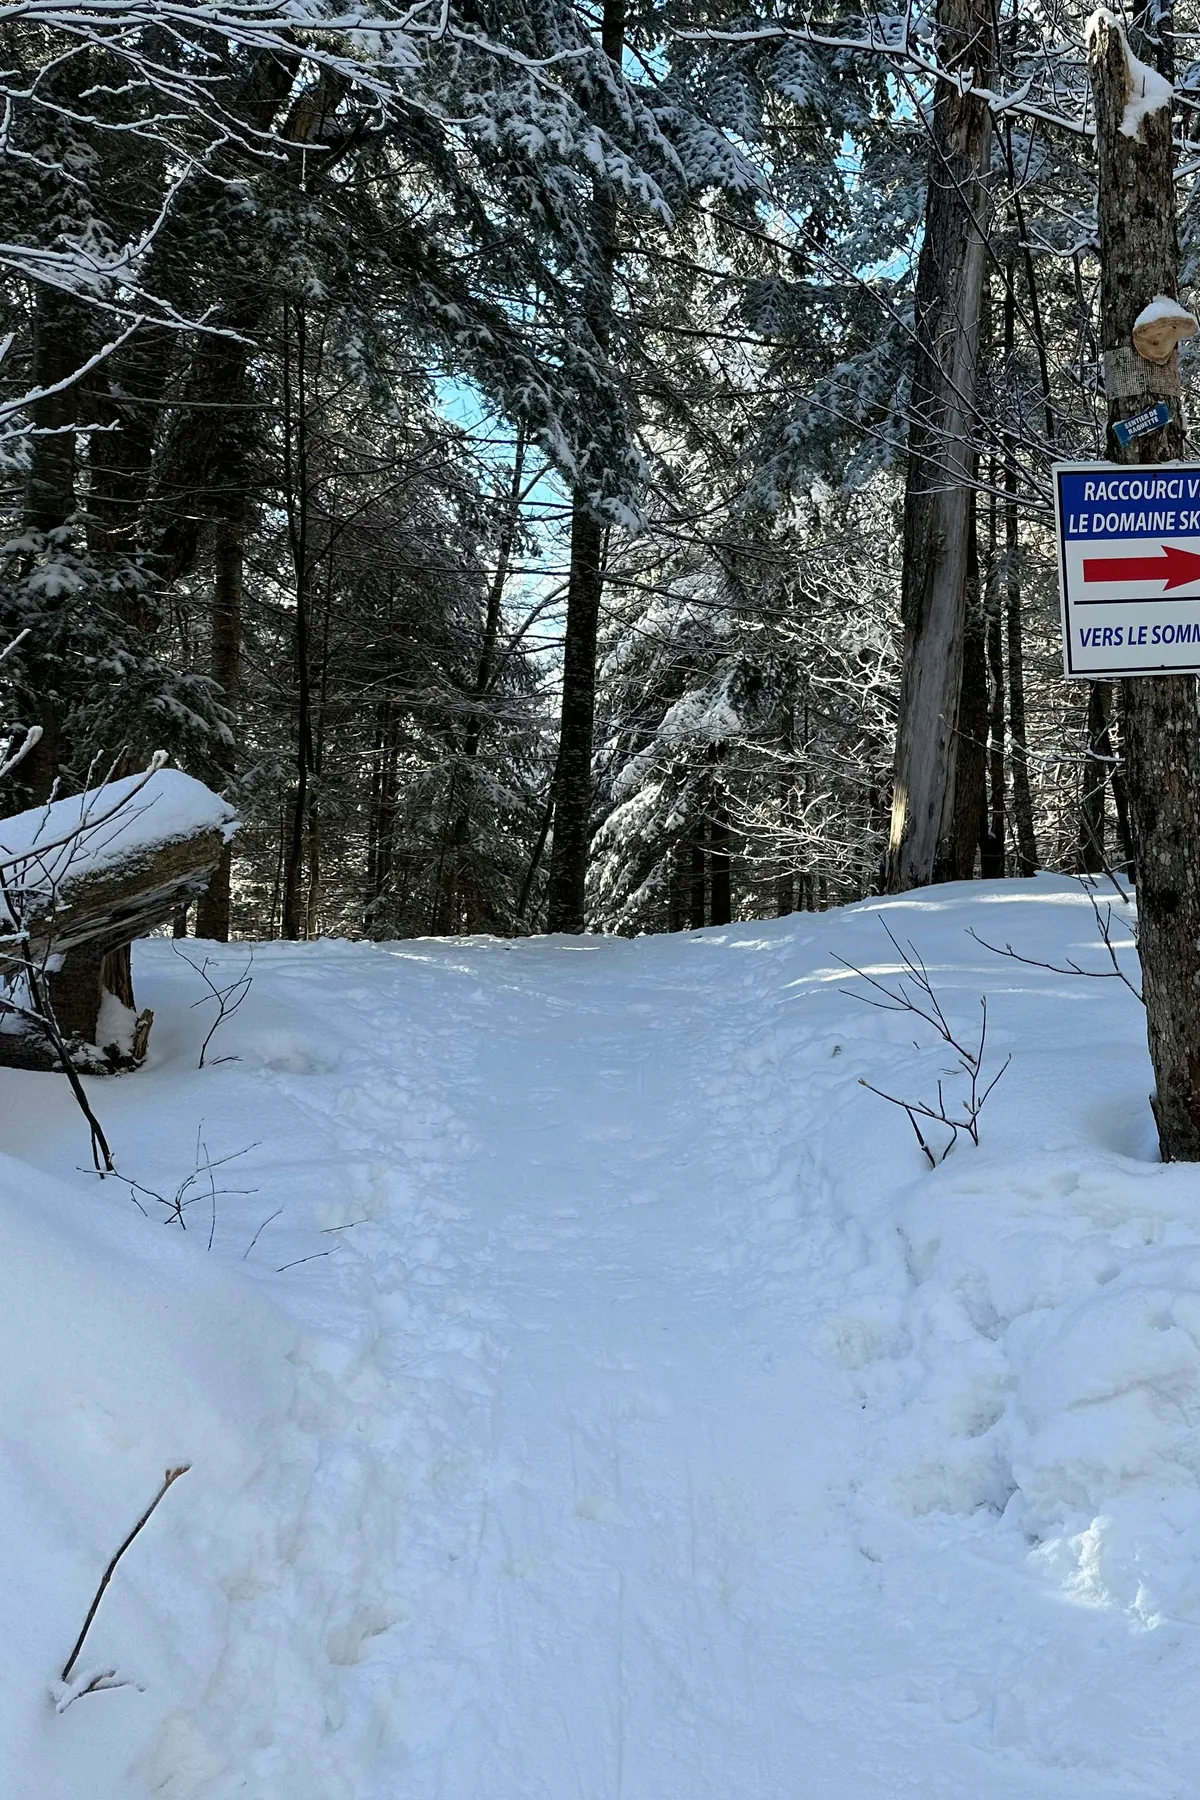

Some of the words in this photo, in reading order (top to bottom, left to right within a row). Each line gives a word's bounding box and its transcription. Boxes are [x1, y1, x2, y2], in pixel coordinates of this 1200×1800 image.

[1124, 413, 1149, 429] SENTIER
[1149, 409, 1158, 417] DE
[1127, 416, 1159, 435] RAQUETTE
[1084, 479, 1183, 501] RACCOURCI
[1069, 513, 1088, 533] LE
[1092, 511, 1176, 533] DOMAINE
[1079, 626, 1123, 647] VERS
[1127, 625, 1148, 645] LE
